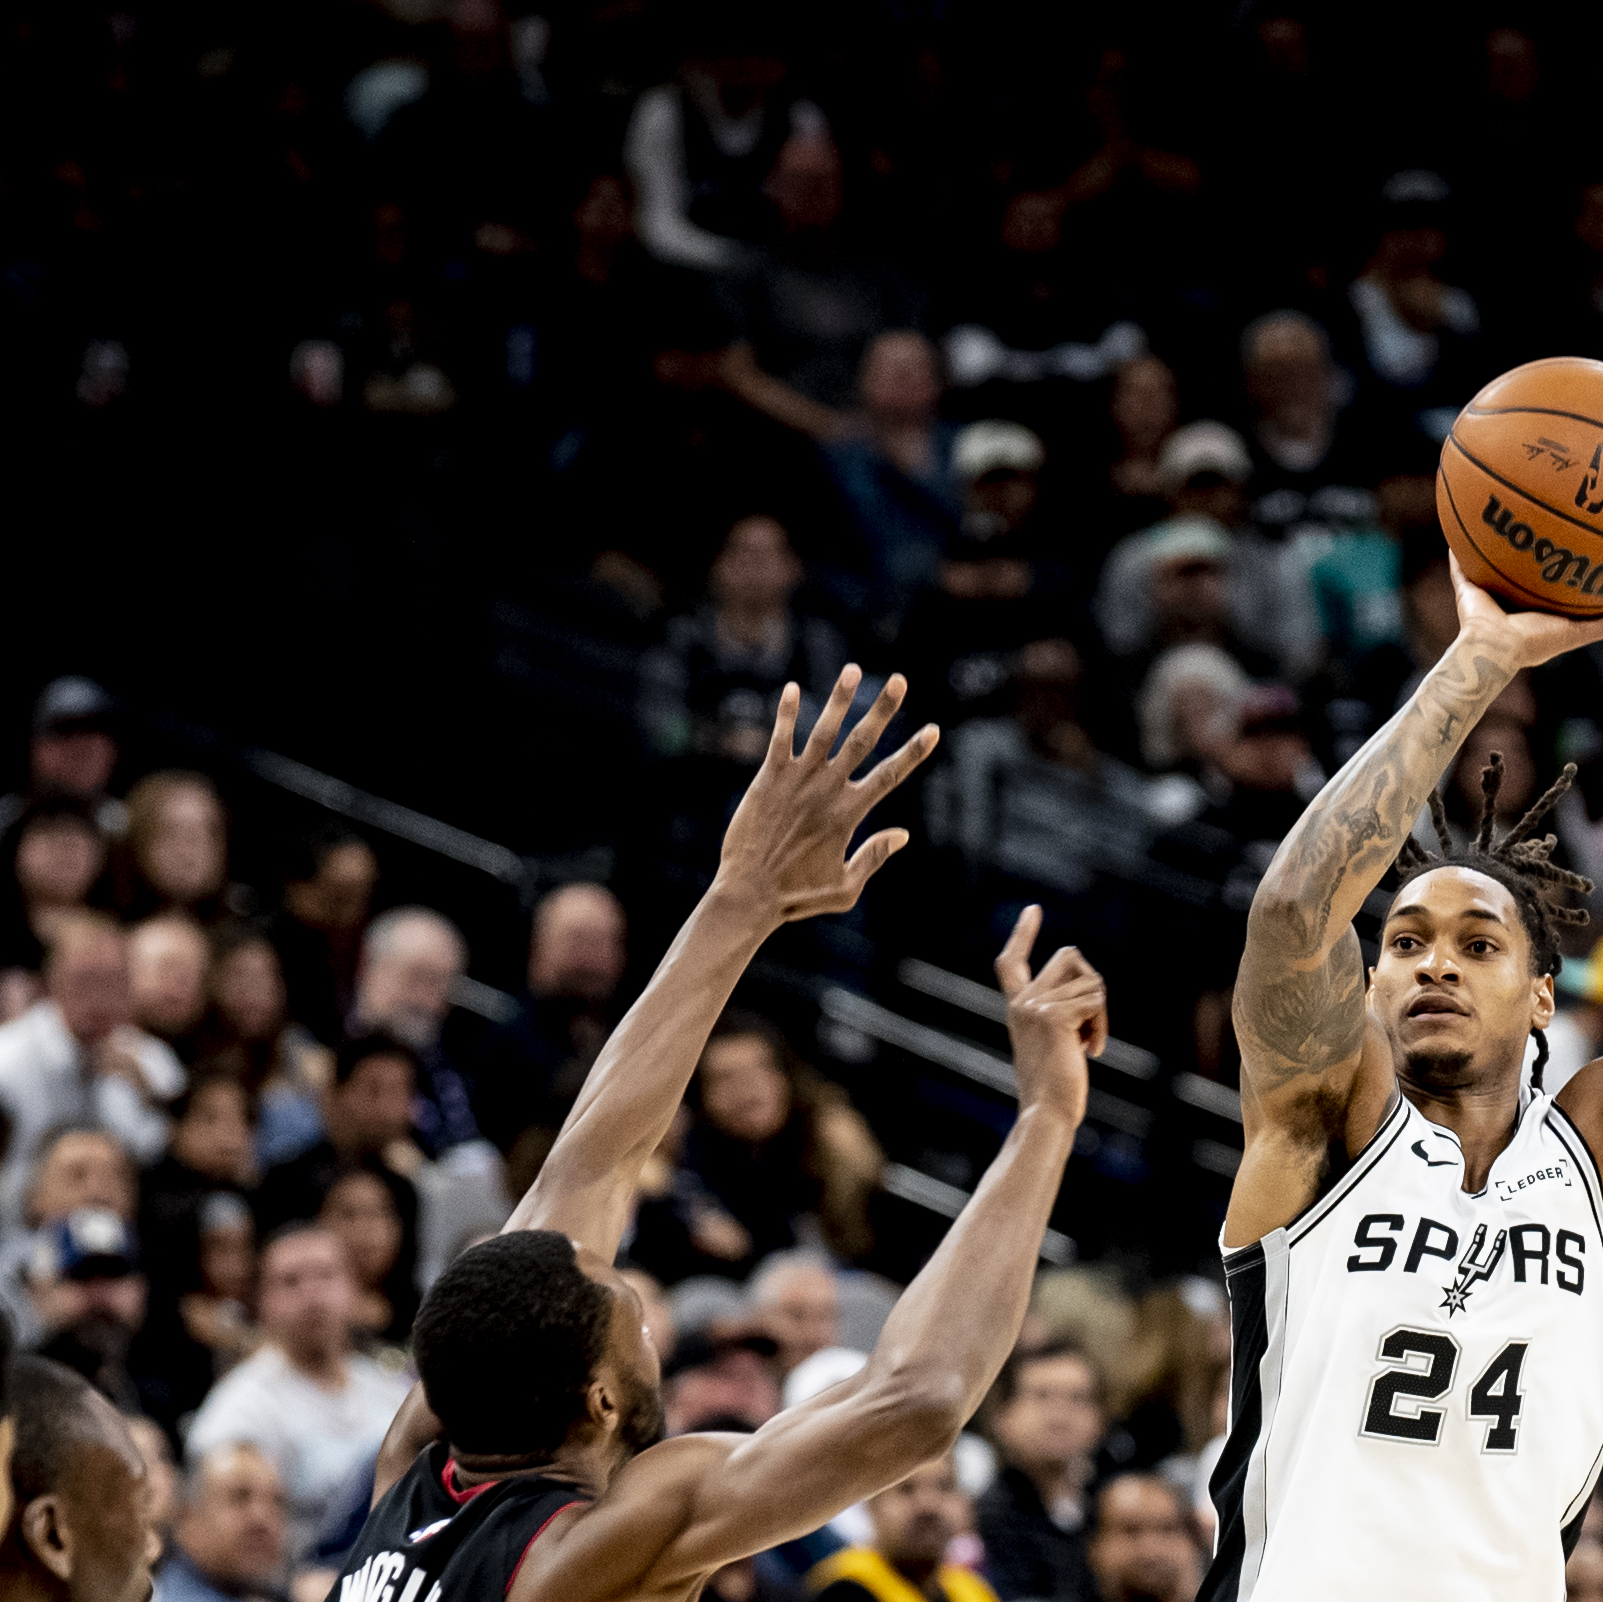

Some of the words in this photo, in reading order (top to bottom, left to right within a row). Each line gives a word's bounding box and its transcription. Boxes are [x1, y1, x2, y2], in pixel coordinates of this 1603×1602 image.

[1506, 1166, 1564, 1194] LEDGER
[1347, 1213, 1586, 1316] SPURS
[1358, 1324, 1530, 1456] 24
